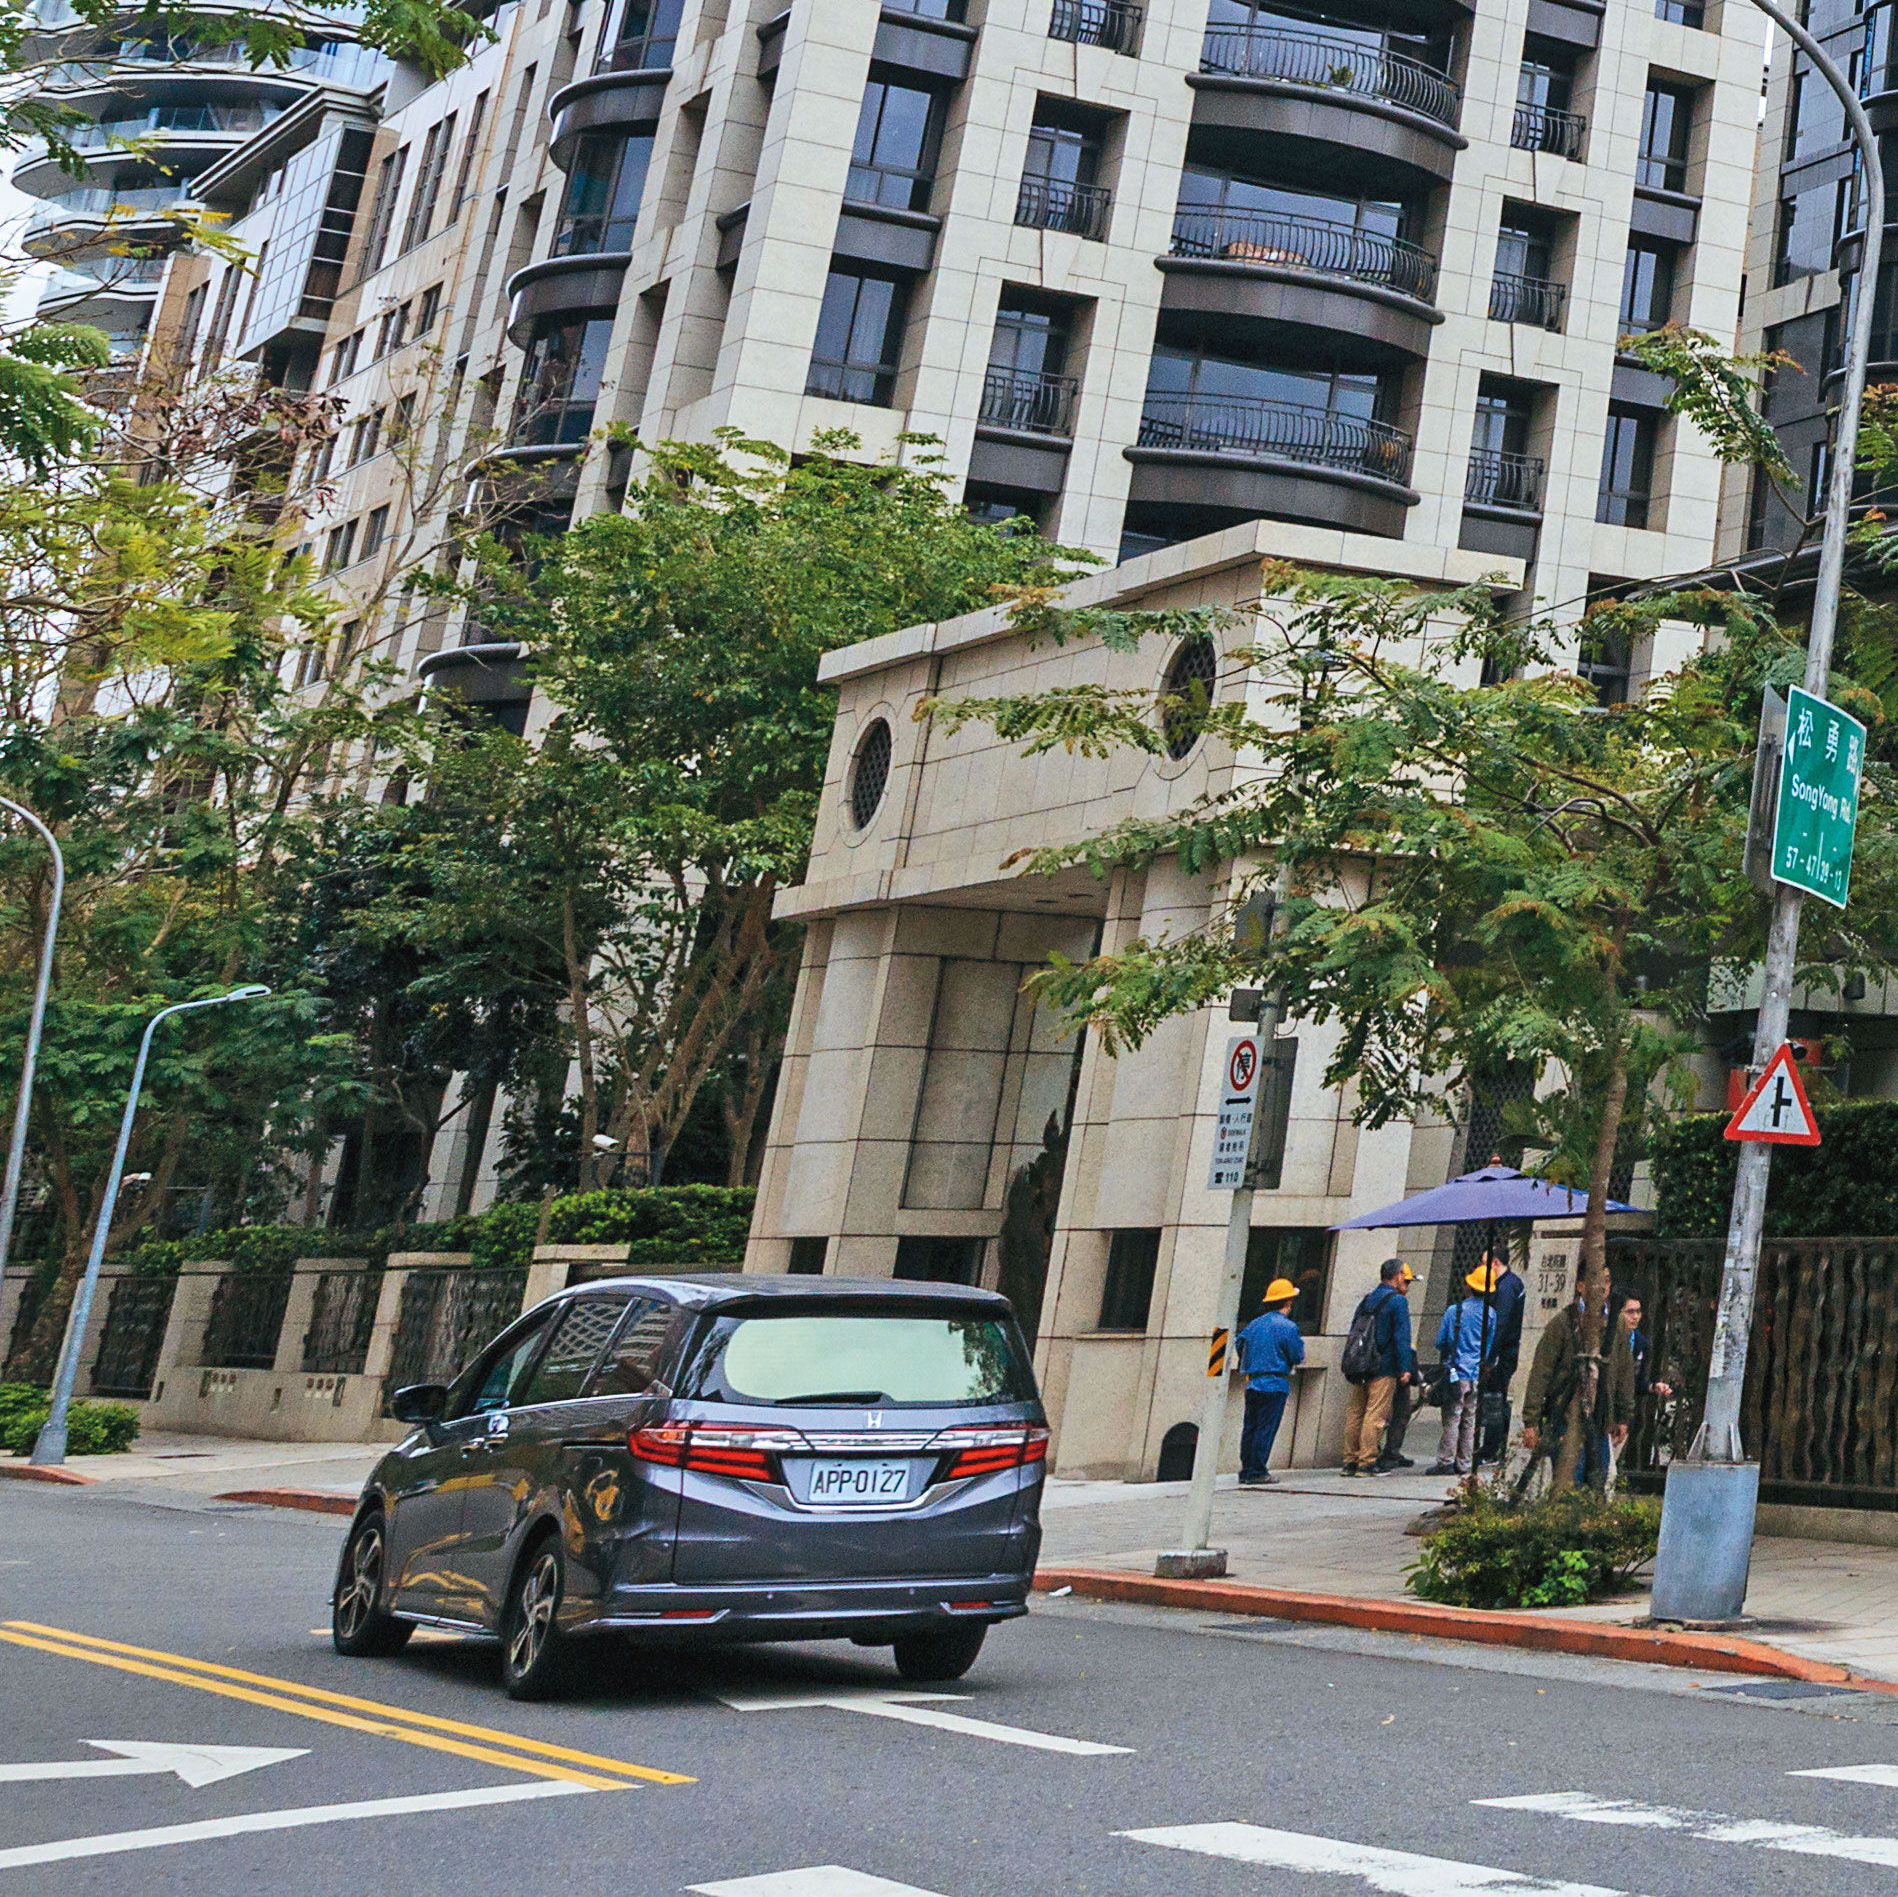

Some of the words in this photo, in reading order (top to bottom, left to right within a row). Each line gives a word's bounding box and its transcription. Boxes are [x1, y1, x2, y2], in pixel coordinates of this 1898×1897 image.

[1797, 708, 1859, 774] 松勇路
[1791, 773, 1839, 821] SongYong
[813, 1469, 906, 1493] APP-0127
